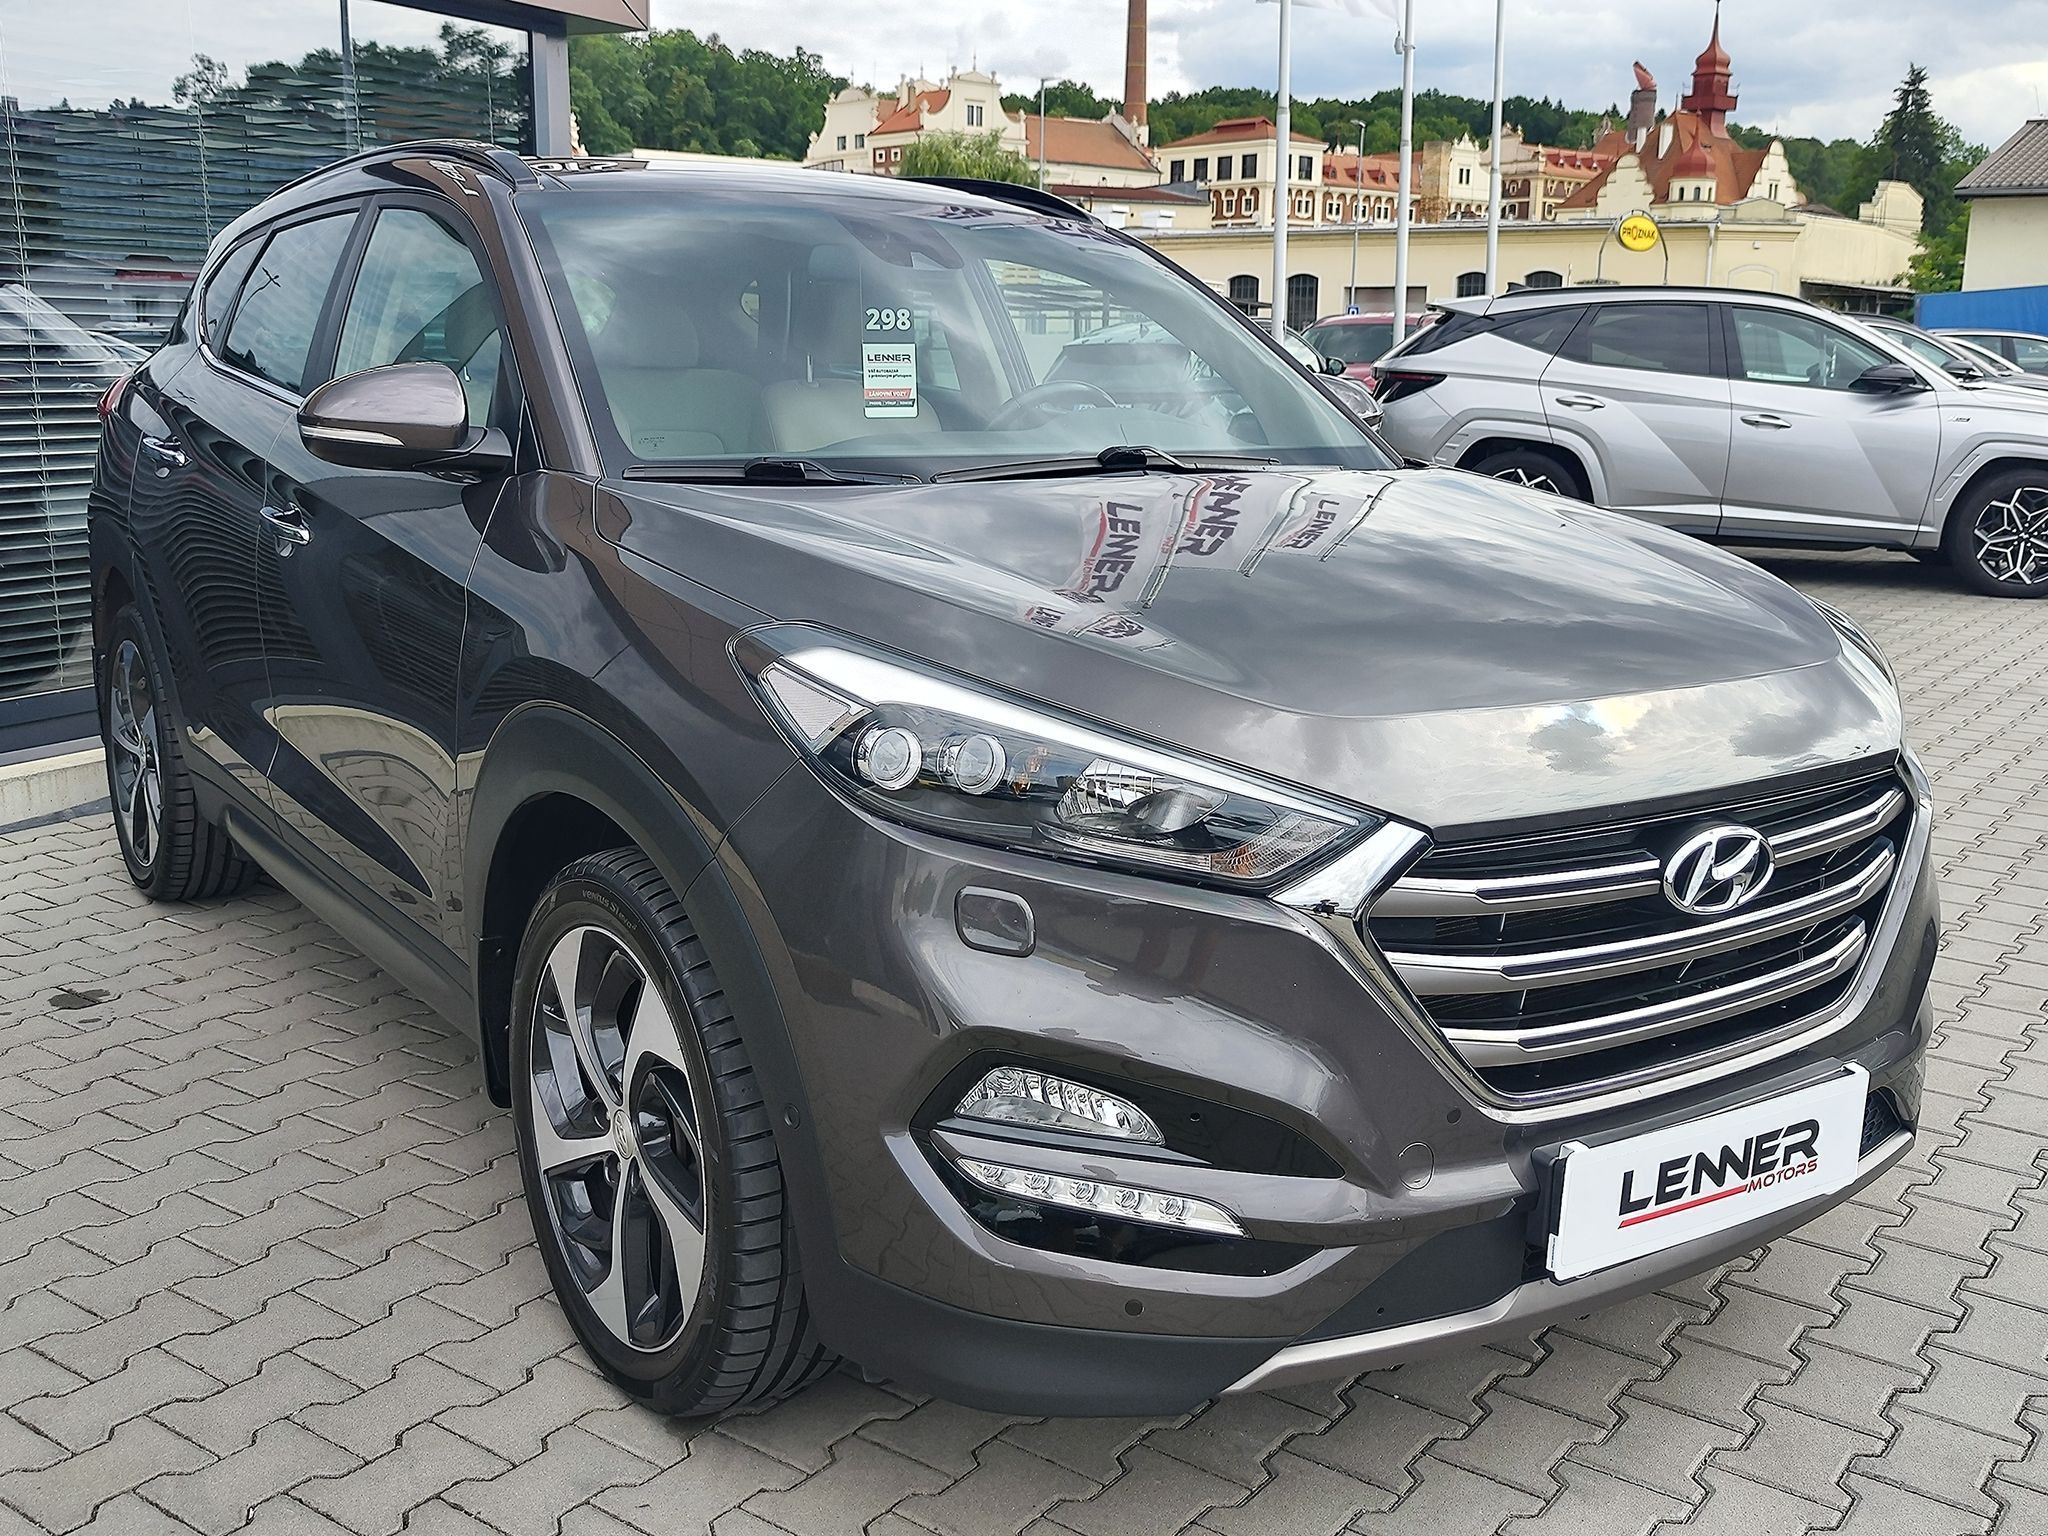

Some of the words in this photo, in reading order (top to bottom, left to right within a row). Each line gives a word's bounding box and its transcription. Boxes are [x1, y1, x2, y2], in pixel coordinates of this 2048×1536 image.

[865, 307, 912, 331] 298
[867, 353, 912, 363] LENNER
[1087, 501, 1143, 595] LENNER
[1618, 1119, 1820, 1216] LENNER
[1747, 1159, 1818, 1193] MOTORS
